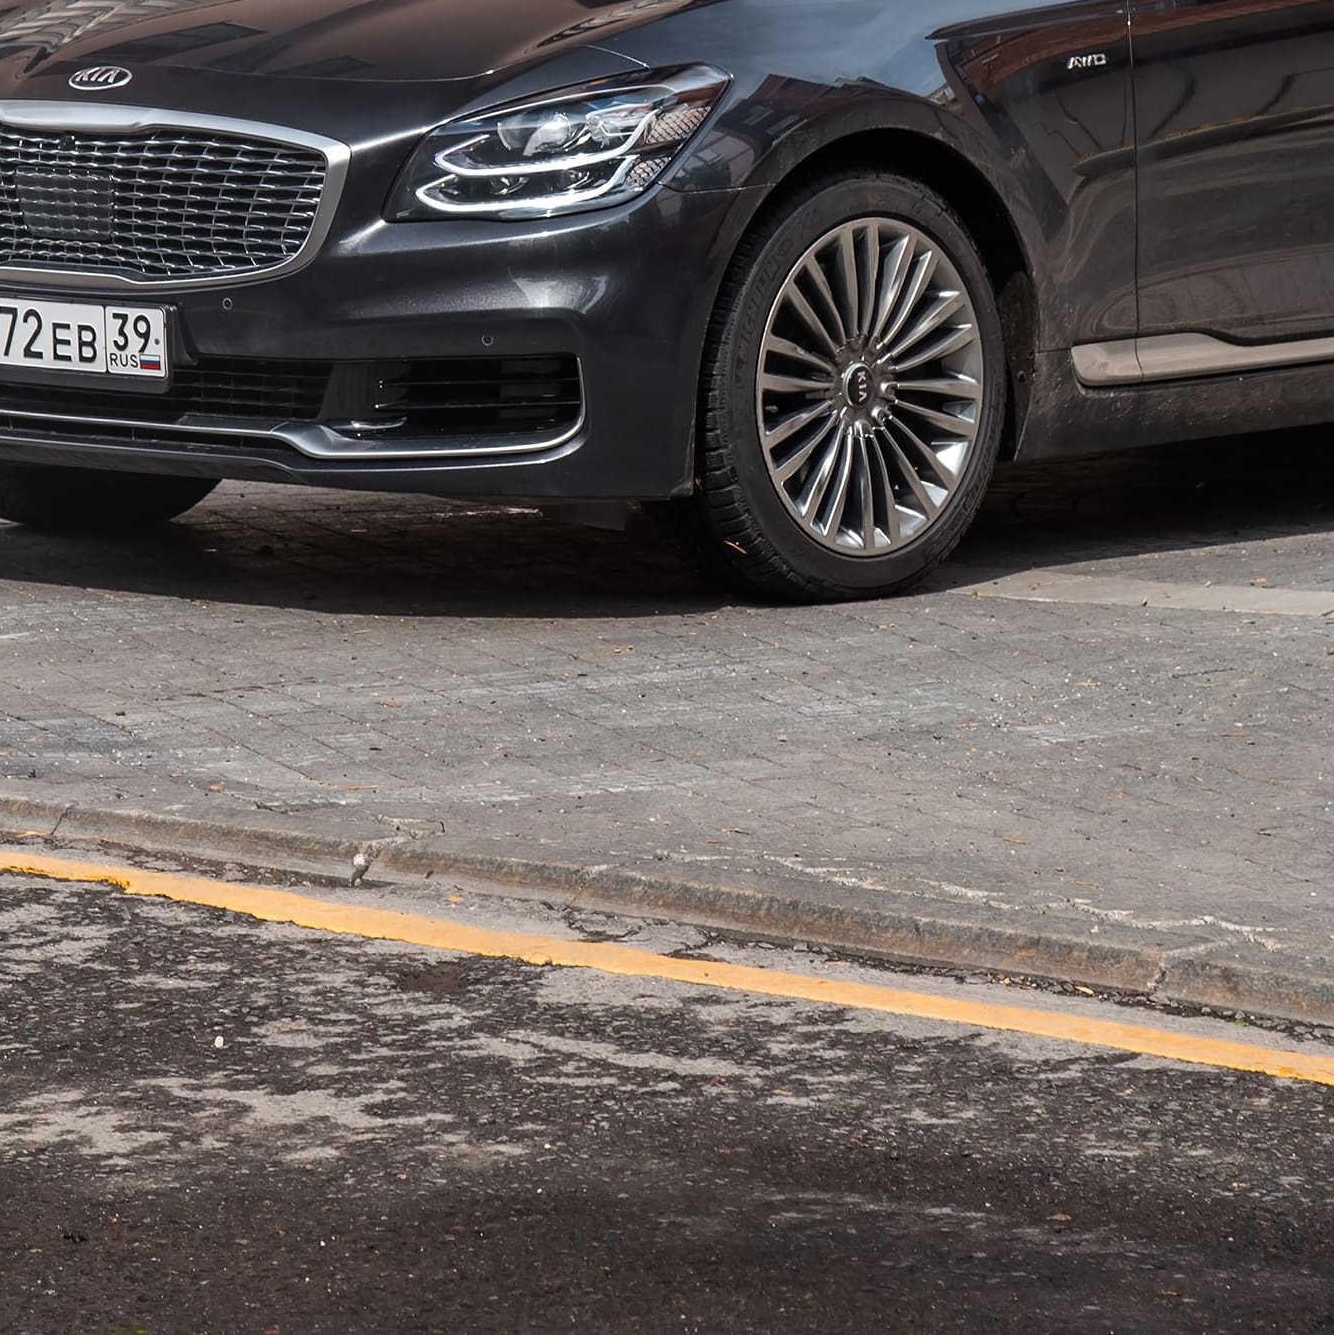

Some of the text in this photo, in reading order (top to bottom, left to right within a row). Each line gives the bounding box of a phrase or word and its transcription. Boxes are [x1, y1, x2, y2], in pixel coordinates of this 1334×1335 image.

[73, 67, 122, 84] KIA
[112, 312, 151, 353] 39
[109, 352, 139, 368] RUS
[857, 371, 867, 402] KIA
